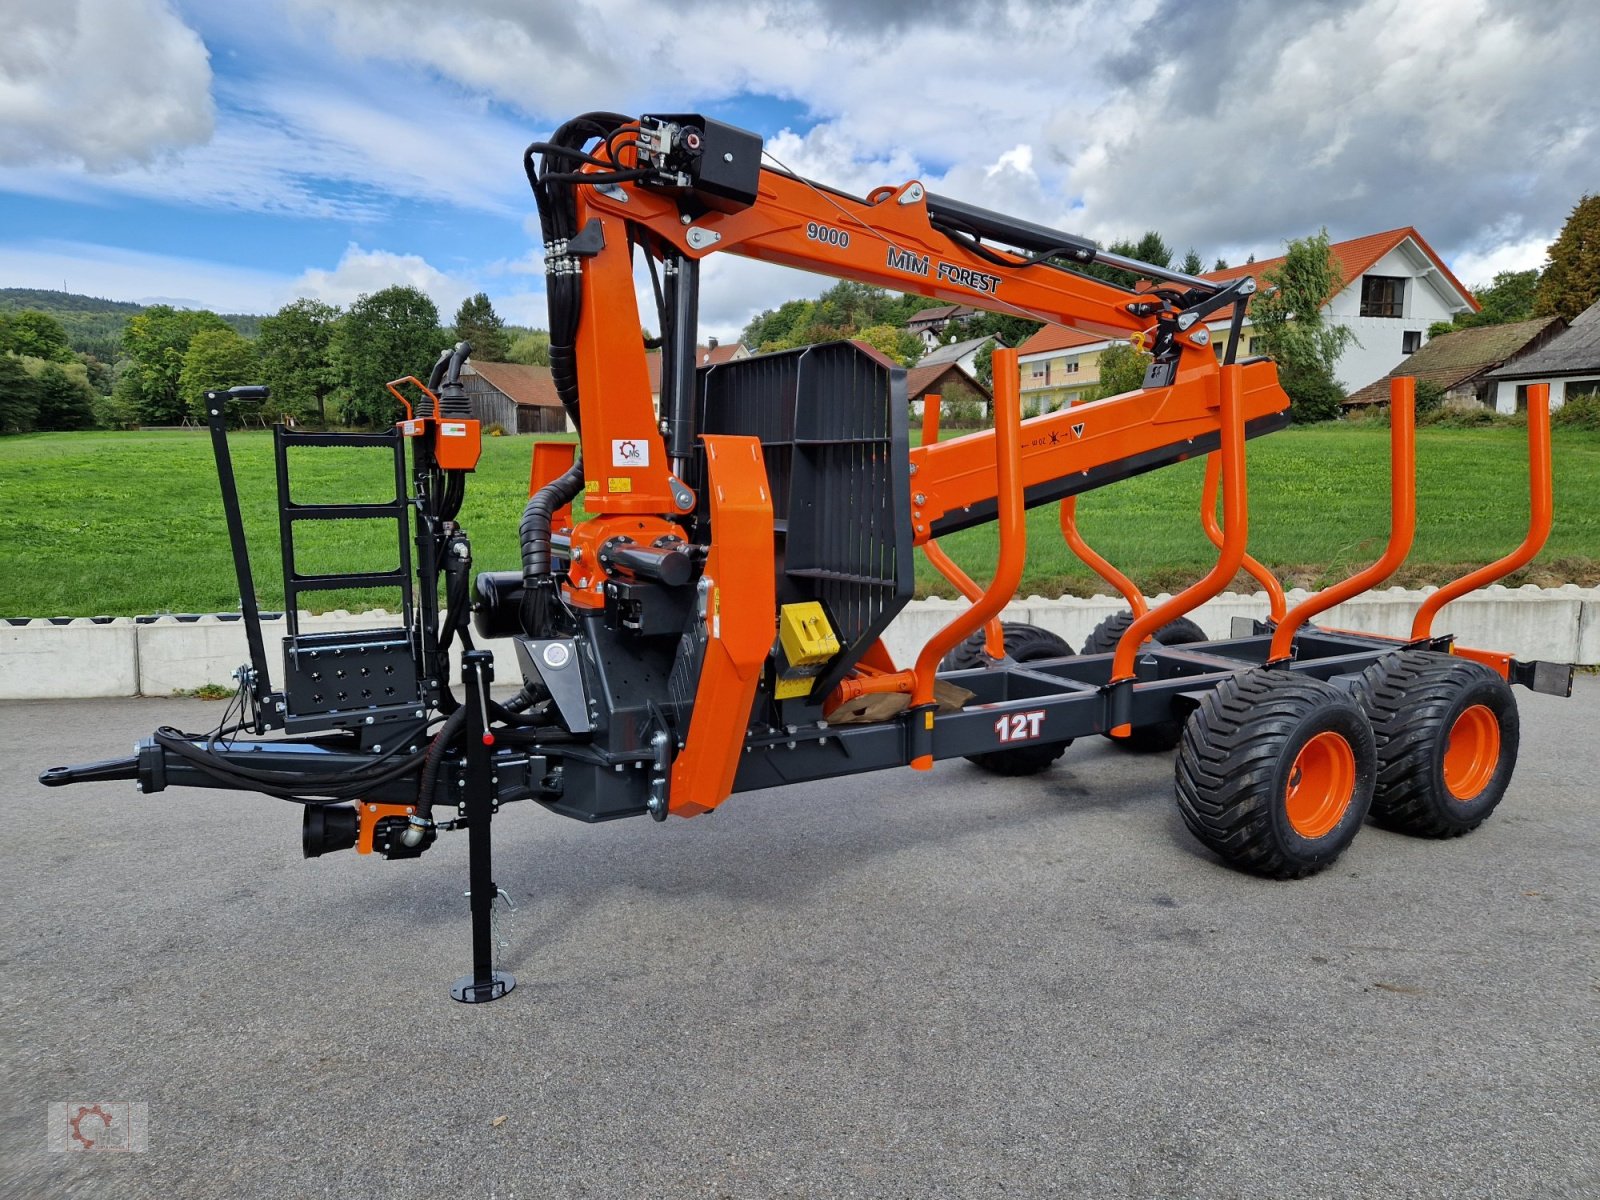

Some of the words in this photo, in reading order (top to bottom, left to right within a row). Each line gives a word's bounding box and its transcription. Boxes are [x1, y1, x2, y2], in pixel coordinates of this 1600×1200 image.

[807, 222, 850, 248] 9000
[886, 245, 929, 277] MTM
[937, 261, 1002, 294] FOREST
[994, 709, 1046, 743] 12T
